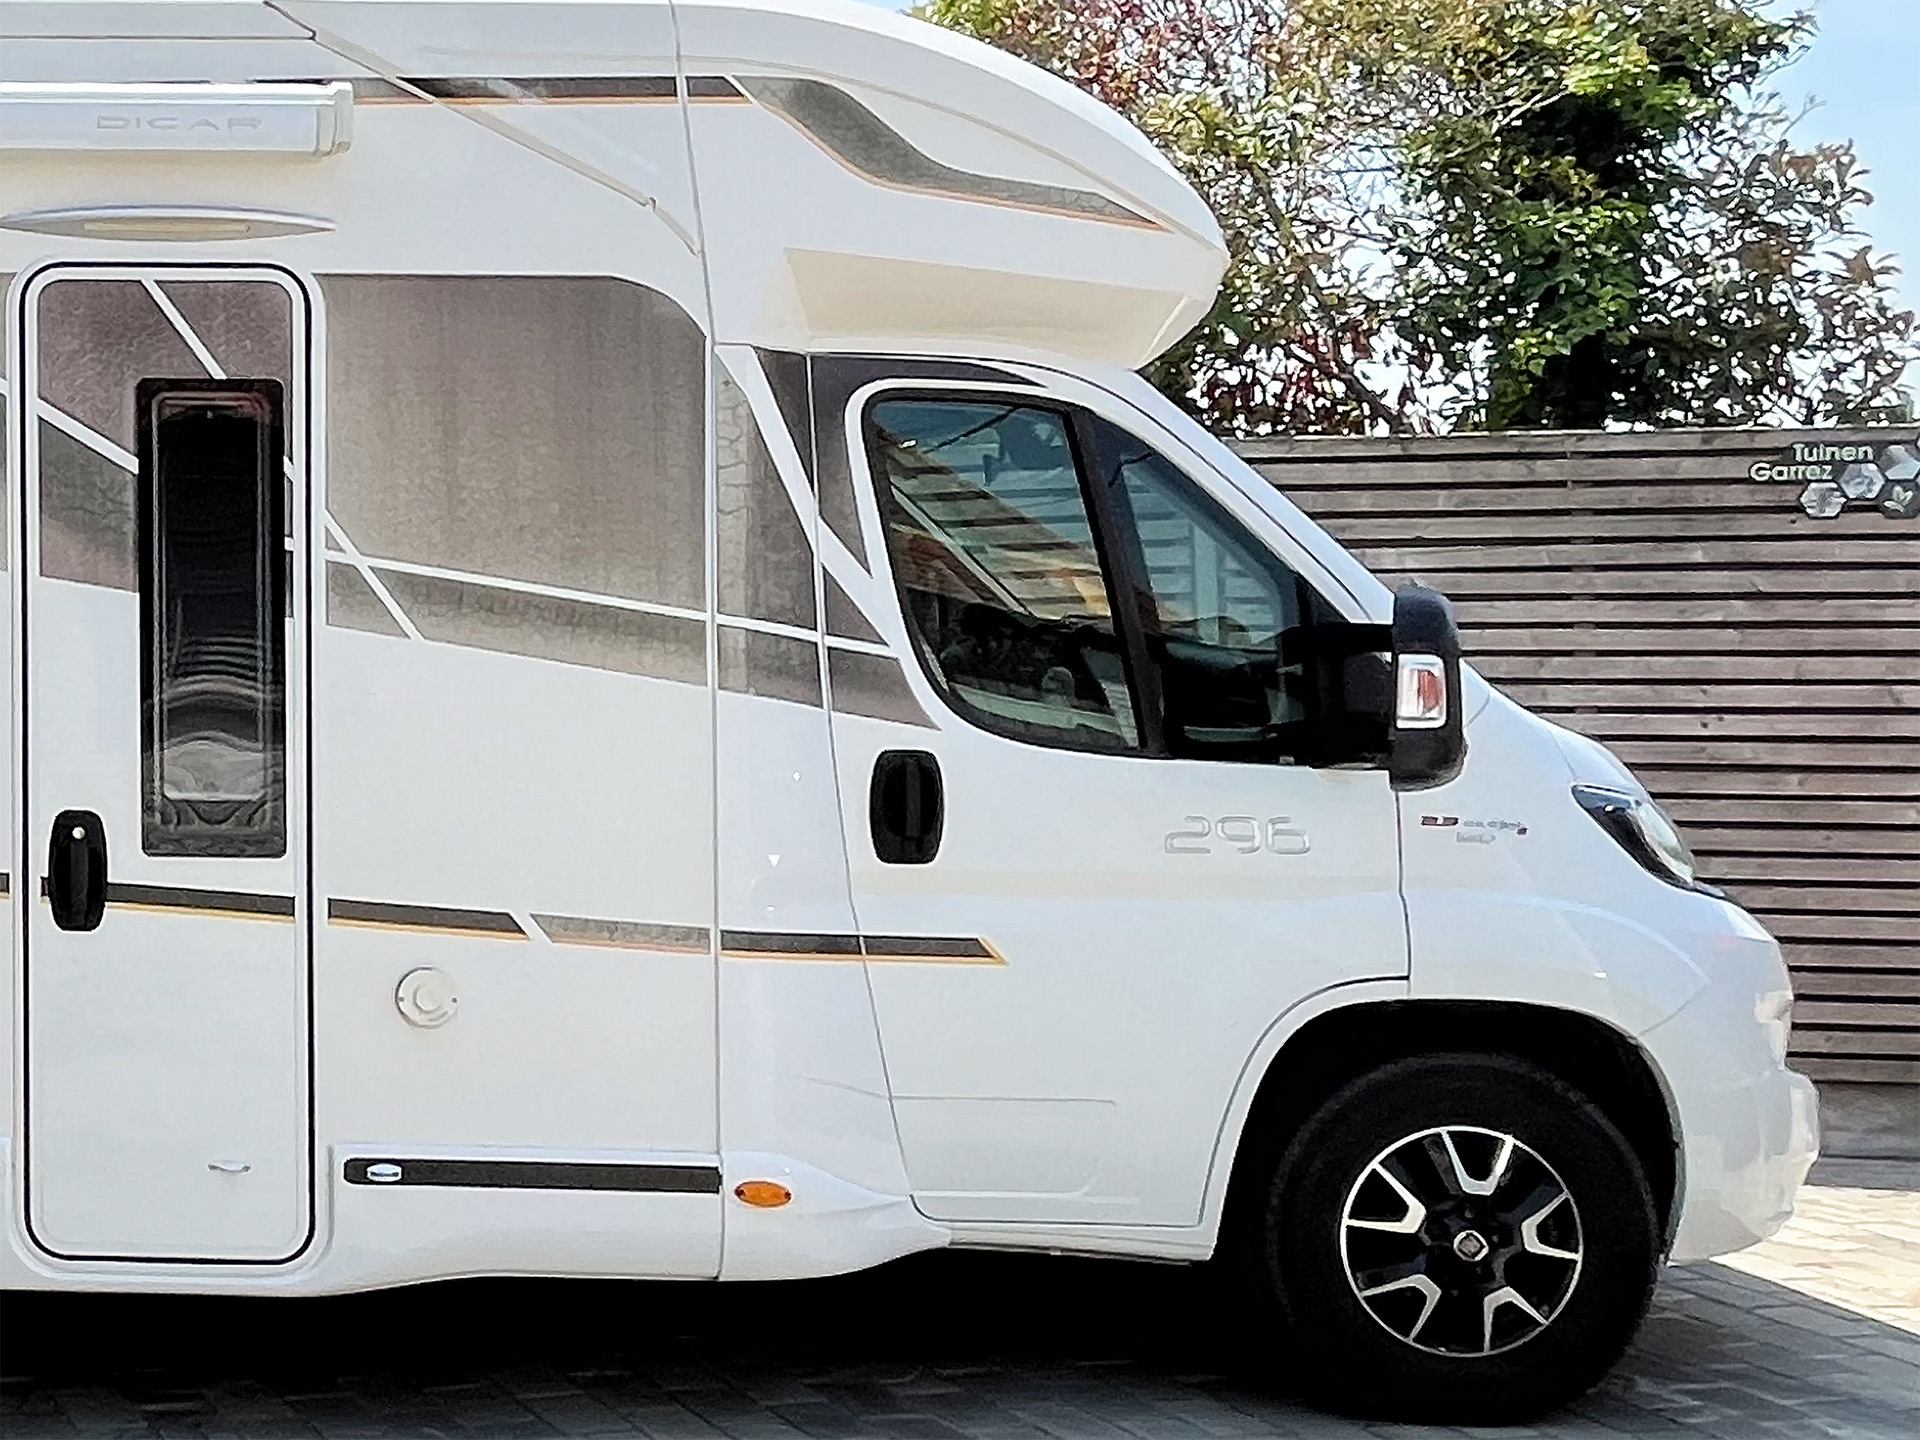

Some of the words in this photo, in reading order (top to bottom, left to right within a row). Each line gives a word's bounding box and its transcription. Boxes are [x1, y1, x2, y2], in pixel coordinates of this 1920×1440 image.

[1792, 442, 1875, 462] Tuinen
[1750, 462, 1833, 482] Garrez
[1164, 814, 1312, 855] 296
